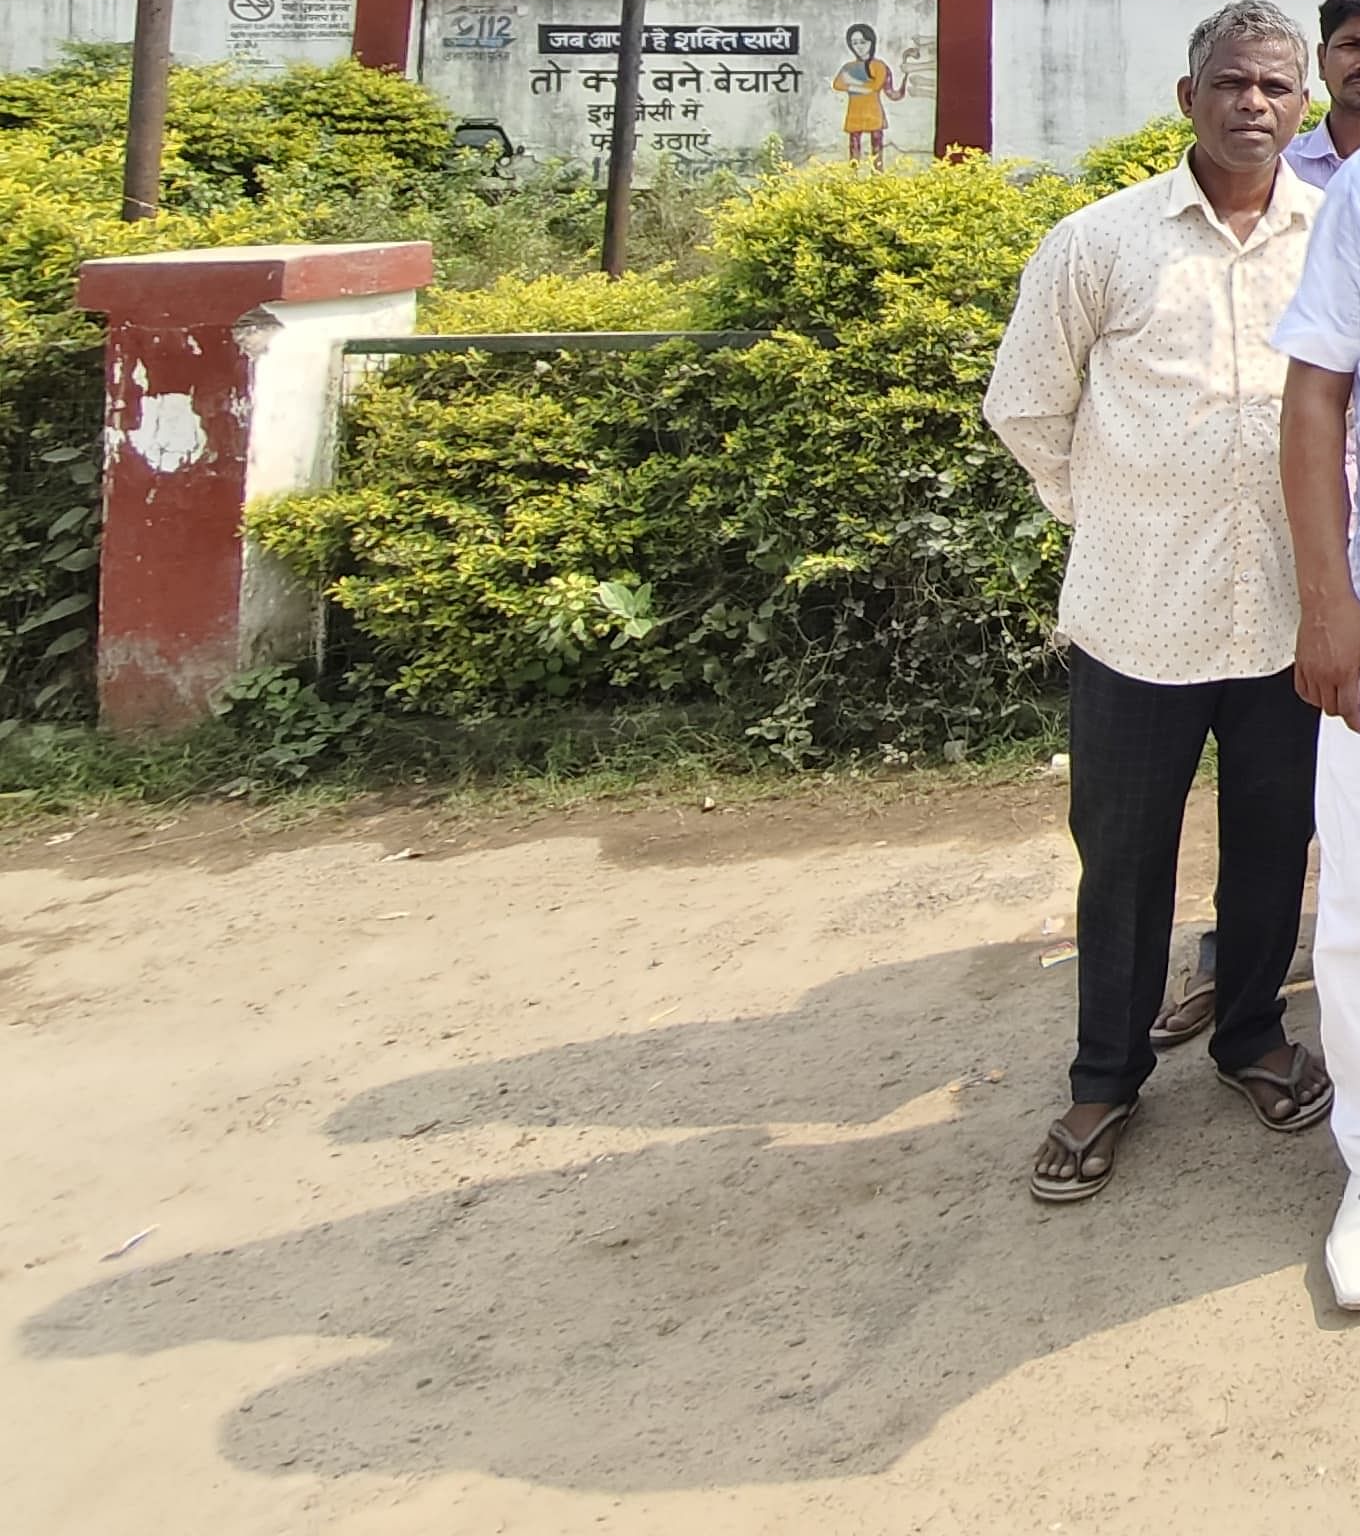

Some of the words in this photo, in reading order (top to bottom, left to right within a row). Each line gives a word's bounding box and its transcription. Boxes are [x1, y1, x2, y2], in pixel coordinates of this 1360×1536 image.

[477, 15, 512, 37] 112
[548, 31, 585, 49] जब
[652, 27, 669, 50] है
[674, 26, 737, 51] शक्ति
[741, 27, 793, 50] सारी
[529, 60, 571, 95] तो
[650, 61, 703, 94] बने
[710, 62, 803, 94] बेचारी
